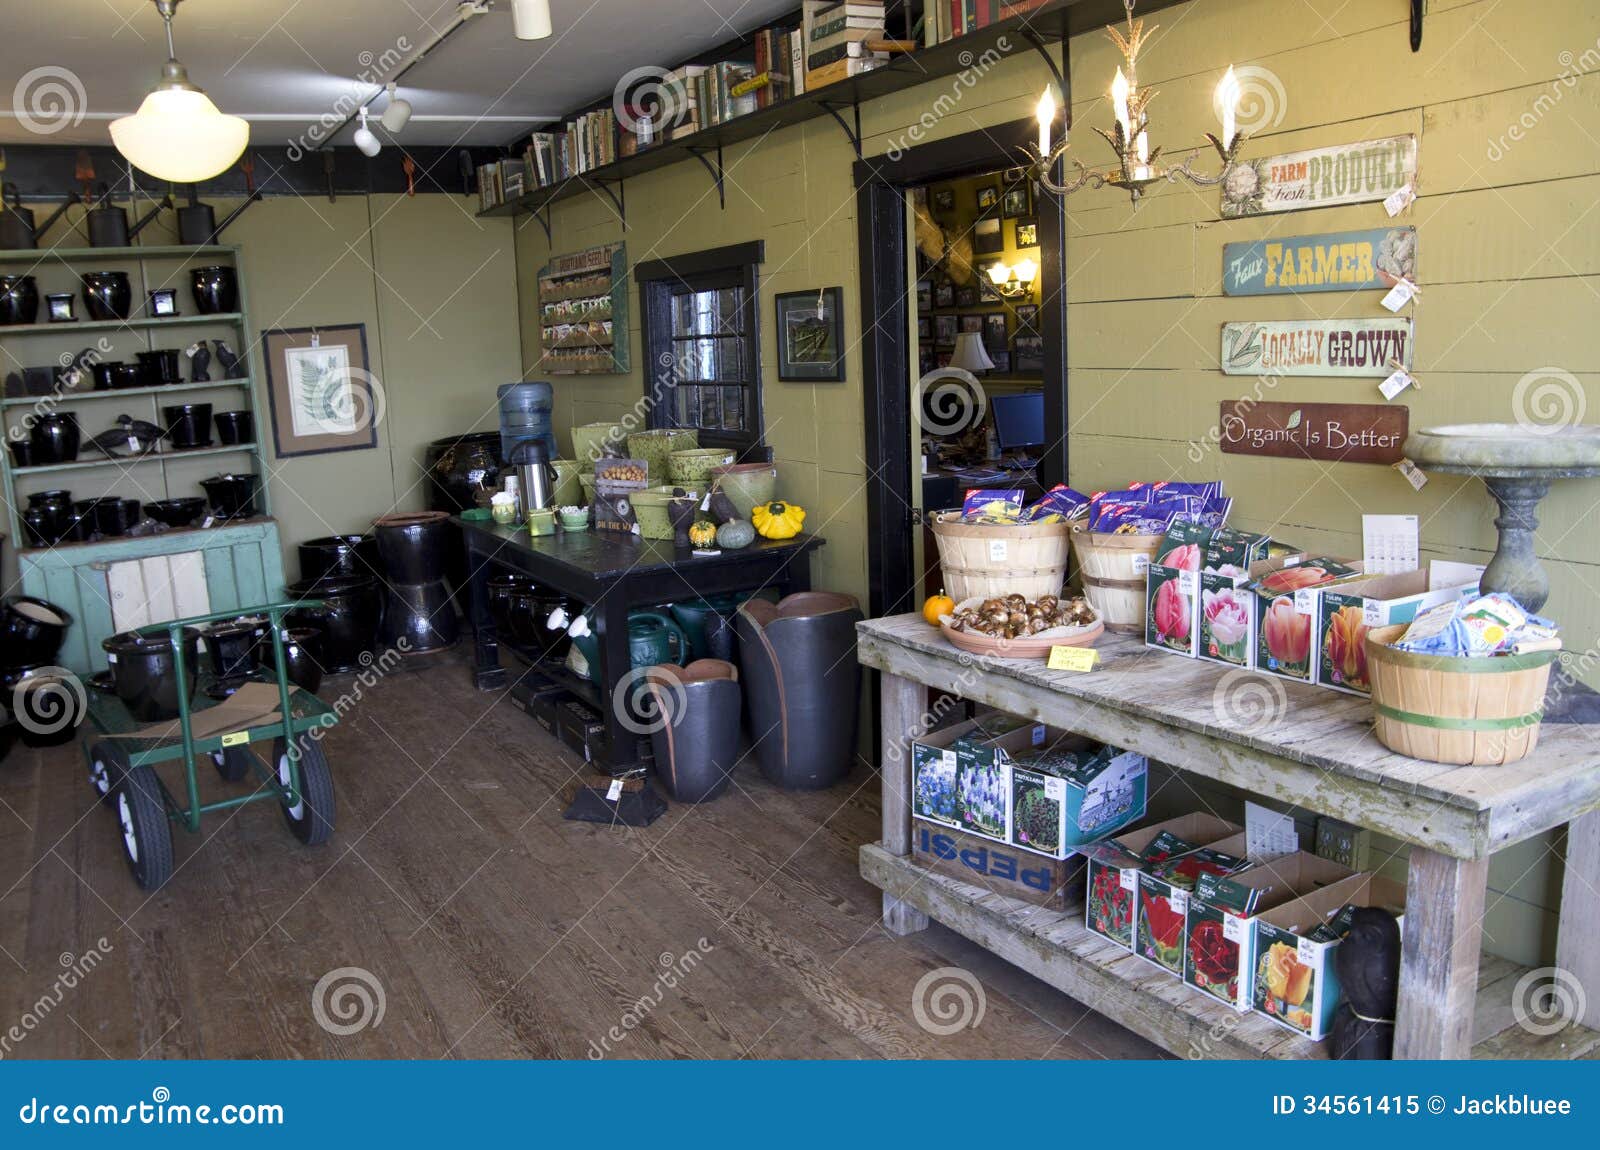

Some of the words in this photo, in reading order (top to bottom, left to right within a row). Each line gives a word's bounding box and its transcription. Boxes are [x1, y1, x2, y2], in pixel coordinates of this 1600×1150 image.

[1271, 161, 1307, 183] FARM
[1309, 143, 1406, 201] PRODUCE
[1268, 184, 1305, 202] Fresh
[587, 249, 602, 268] SEED
[1231, 257, 1263, 288] Faux
[1265, 242, 1374, 287] FARMER
[1261, 330, 1324, 368] LOCALLY
[1328, 330, 1407, 367] GROWN
[1226, 416, 1299, 448] Organic
[1305, 420, 1320, 447] Is
[1327, 421, 1400, 449] Better
[920, 828, 1051, 892] PEPSI
